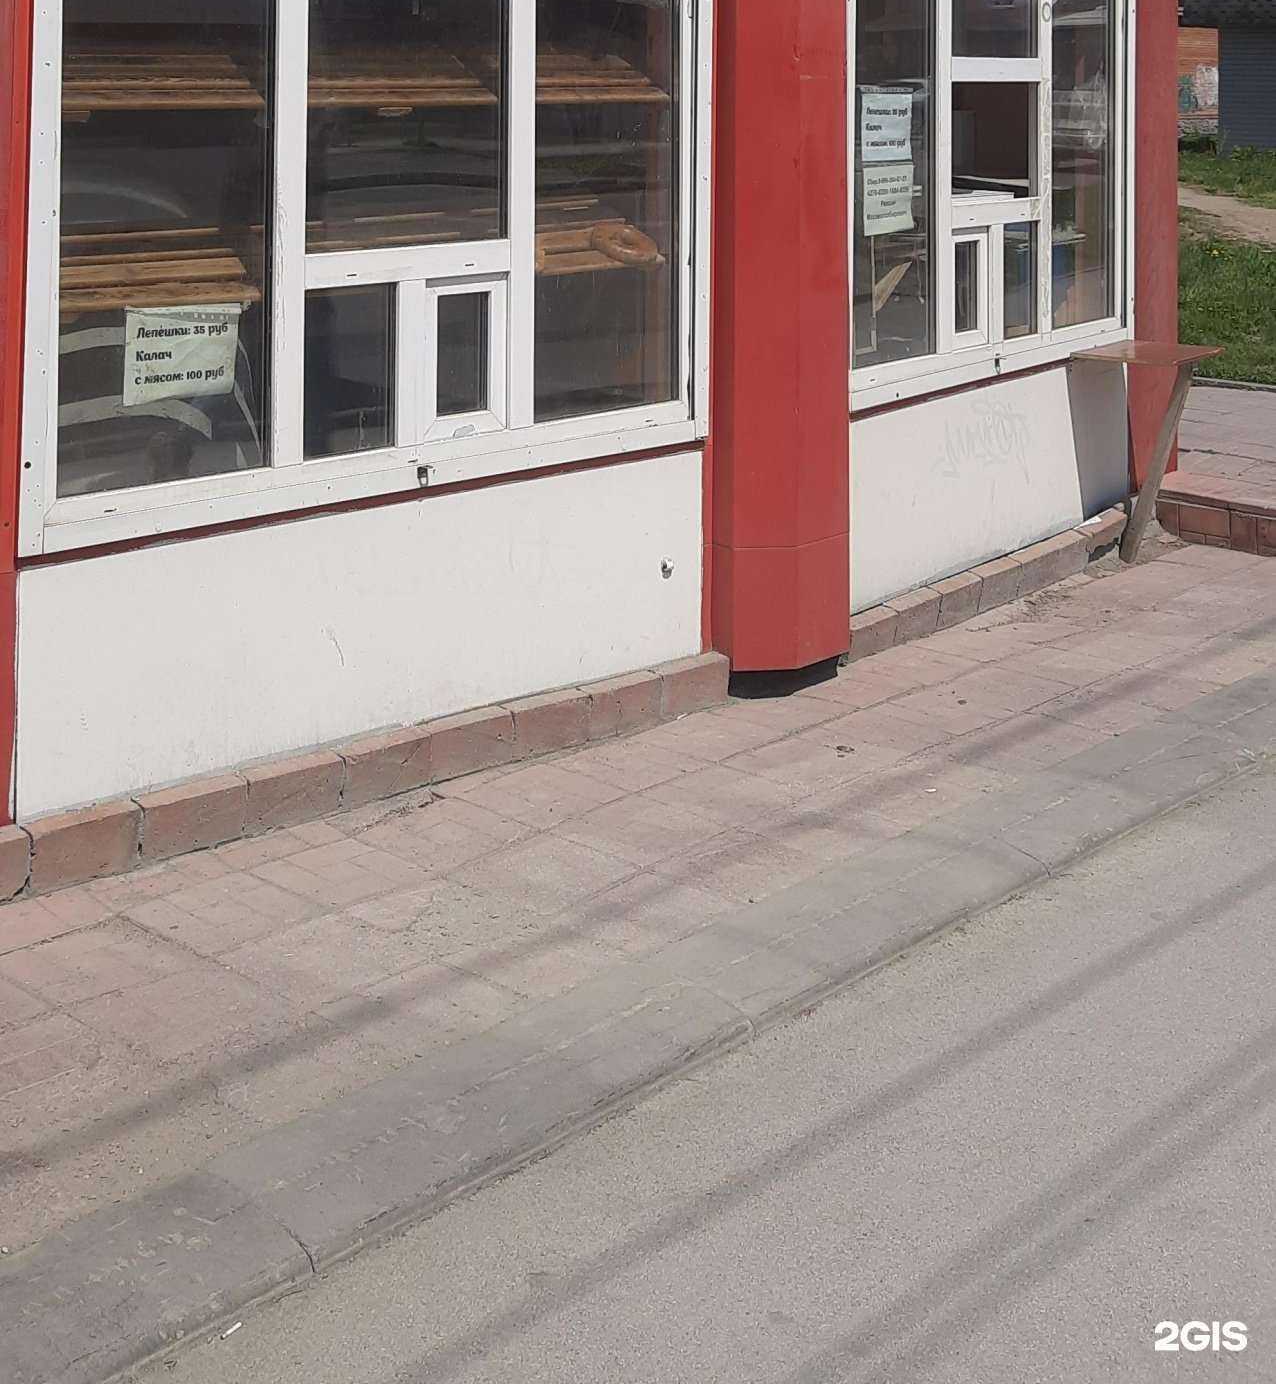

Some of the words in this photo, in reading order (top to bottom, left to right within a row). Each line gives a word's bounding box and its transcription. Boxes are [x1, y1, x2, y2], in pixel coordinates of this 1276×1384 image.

[193, 325, 206, 335] 35
[208, 321, 229, 337] руб
[135, 350, 172, 362] Калач
[134, 376, 142, 385] с
[143, 372, 184, 385] мясом:
[186, 370, 203, 380] 100
[204, 365, 225, 381] руб
